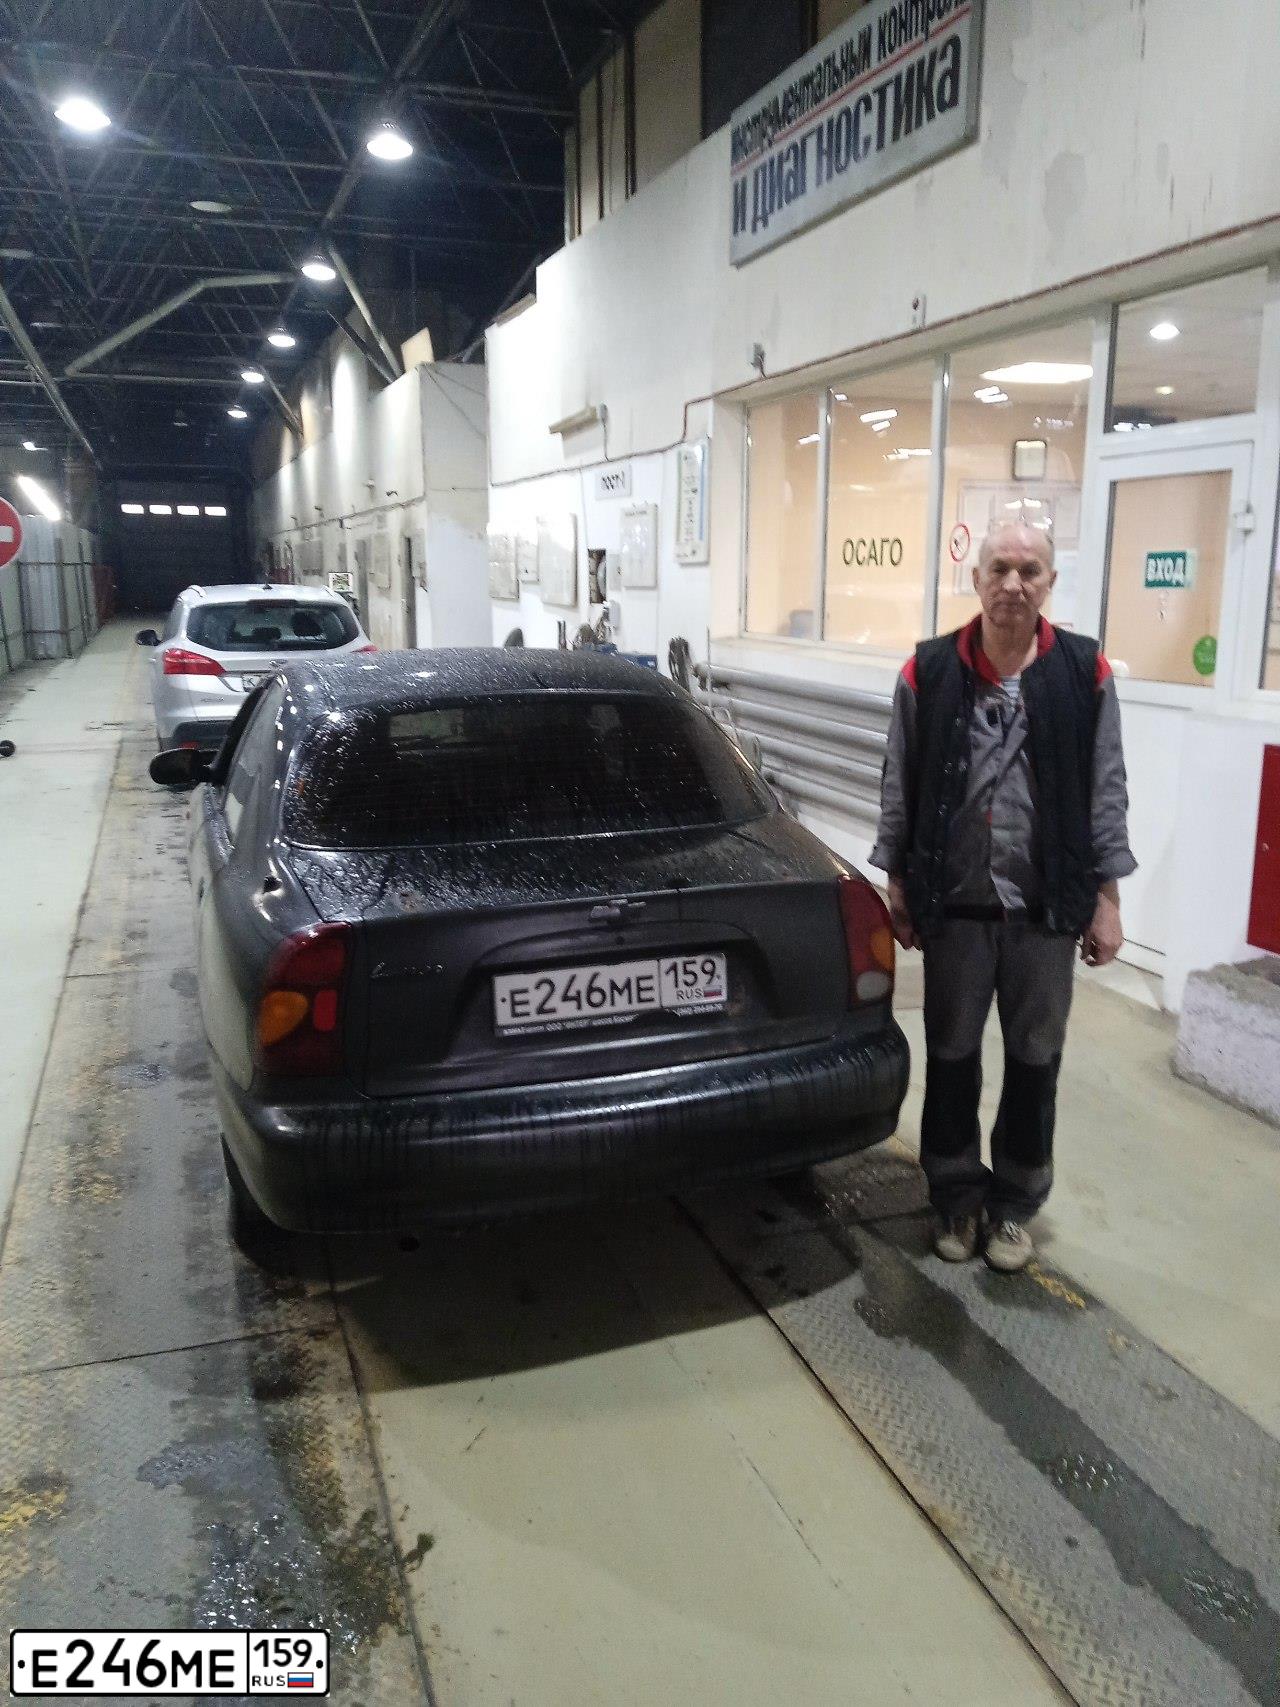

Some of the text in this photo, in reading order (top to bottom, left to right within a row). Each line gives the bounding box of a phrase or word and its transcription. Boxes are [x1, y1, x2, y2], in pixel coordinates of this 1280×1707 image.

[842, 537, 903, 567] ОСАГО
[1146, 556, 1185, 587] ВХОД
[665, 959, 716, 988] 159
[676, 988, 703, 1000] RUS
